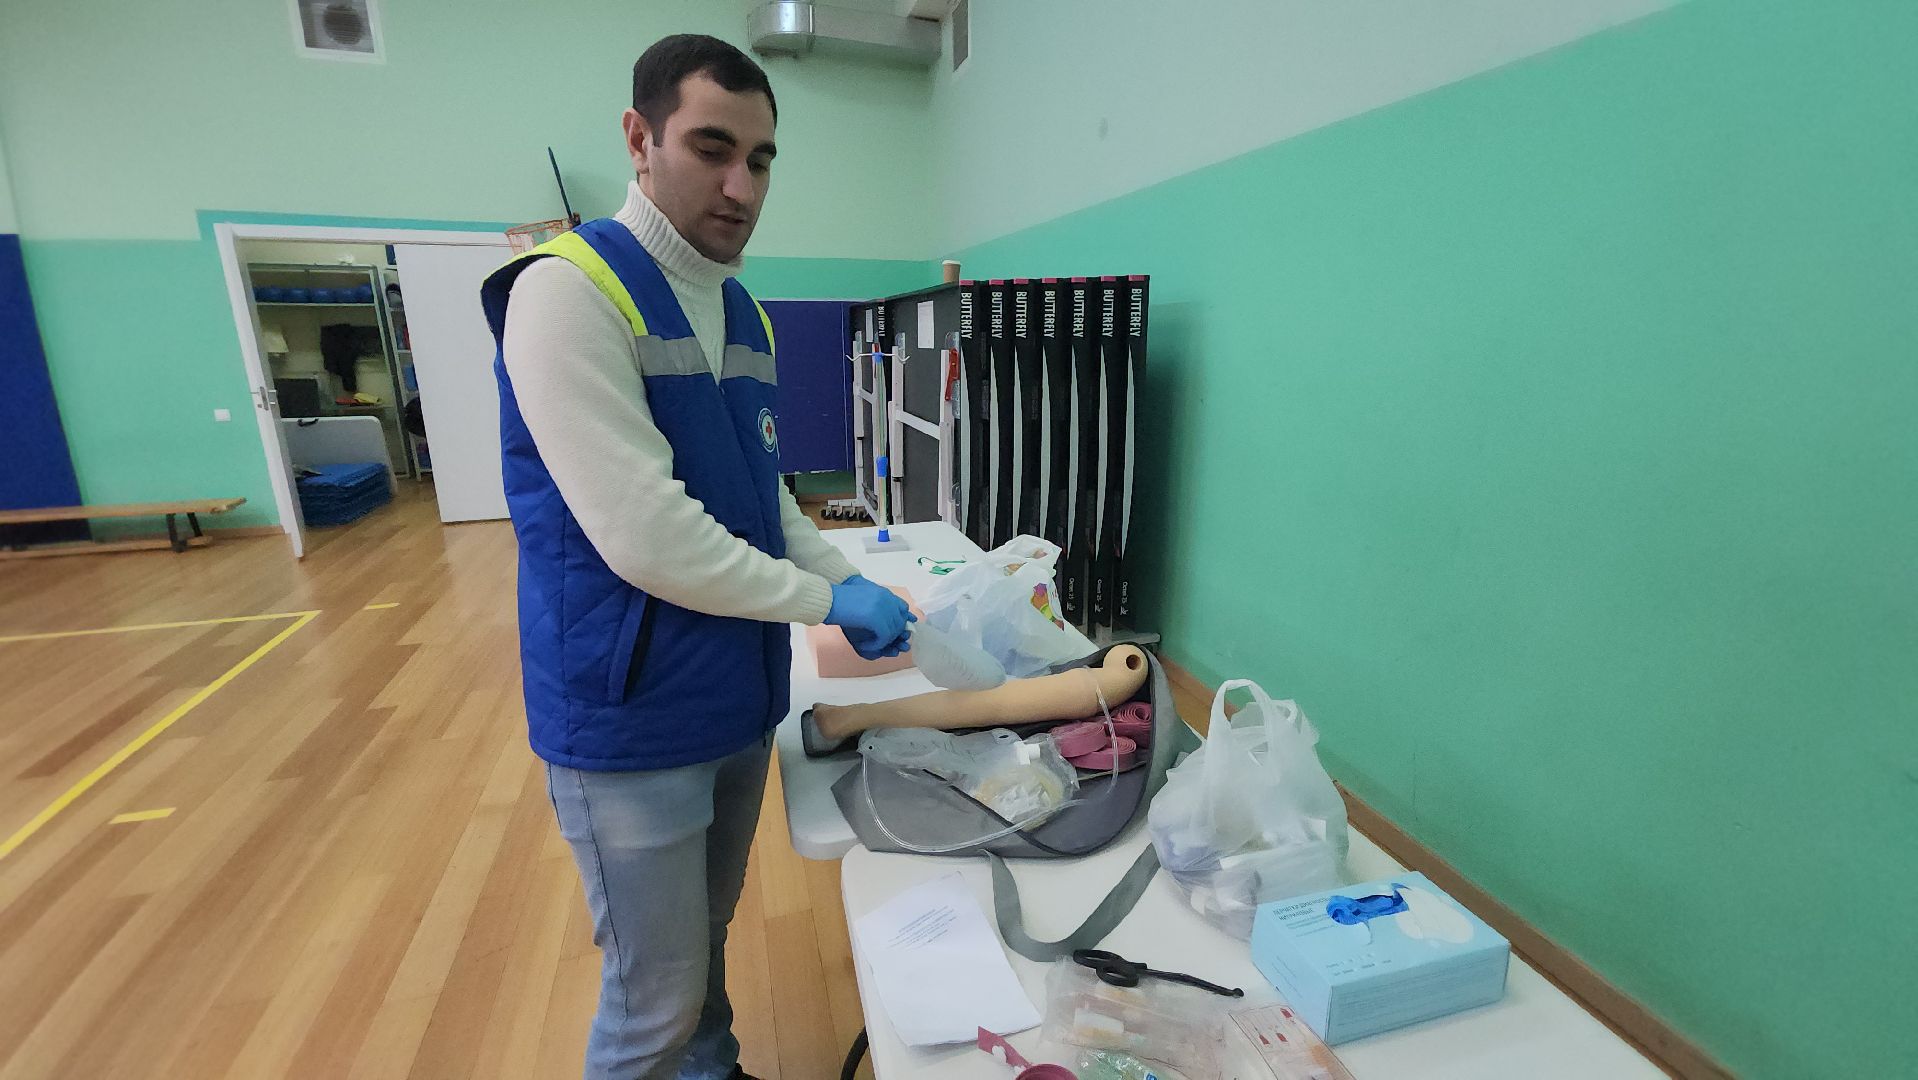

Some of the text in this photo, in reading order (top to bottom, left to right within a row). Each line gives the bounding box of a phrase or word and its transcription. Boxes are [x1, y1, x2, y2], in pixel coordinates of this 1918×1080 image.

[960, 292, 973, 340] BUTTERFLY
[991, 291, 1003, 339] BUTTERFLY
[1015, 291, 1028, 339] BUTTERFLY
[1043, 290, 1056, 339] BUTTERFLY
[1072, 289, 1085, 338] BUTTERFLY
[1101, 289, 1115, 338] BUTTERFLY
[1129, 288, 1143, 337] BUTTERFLY
